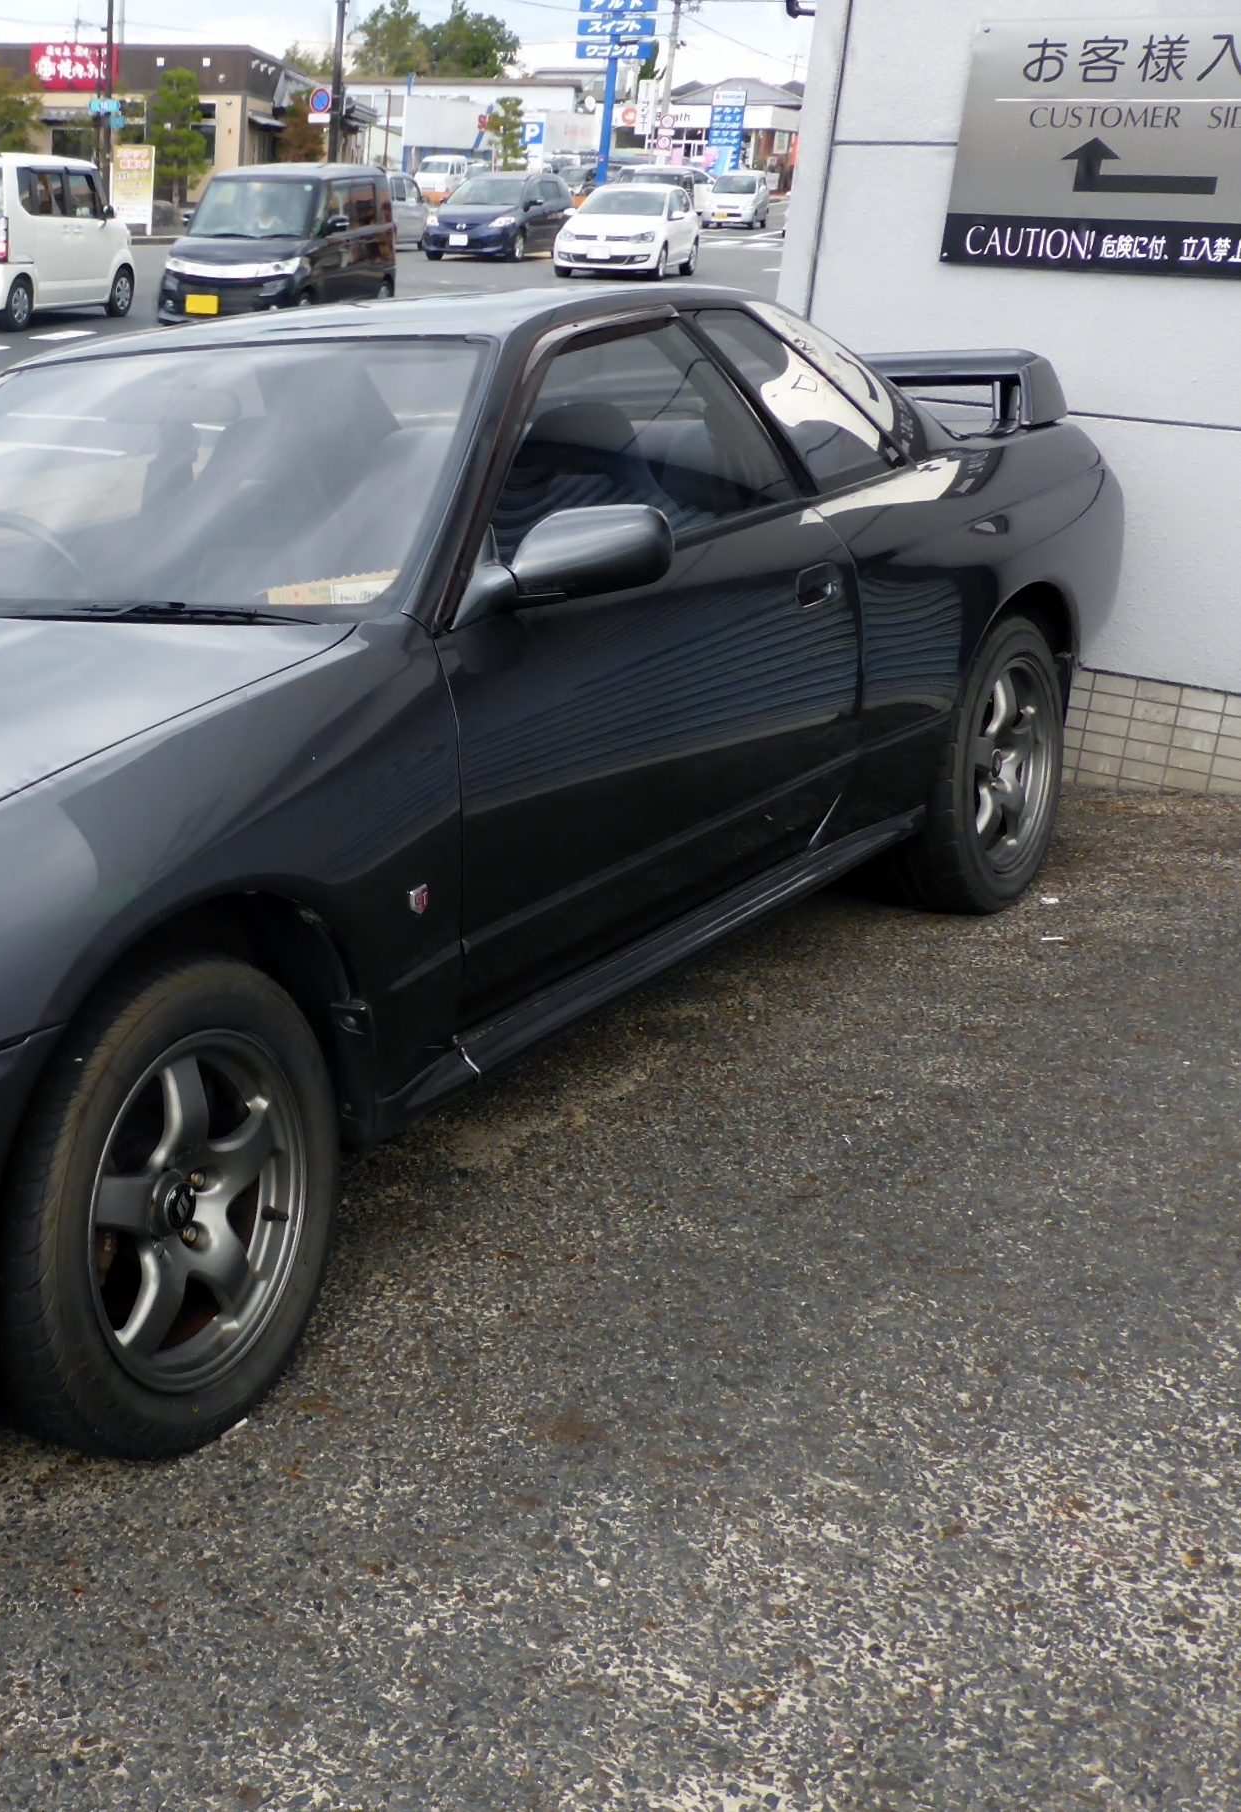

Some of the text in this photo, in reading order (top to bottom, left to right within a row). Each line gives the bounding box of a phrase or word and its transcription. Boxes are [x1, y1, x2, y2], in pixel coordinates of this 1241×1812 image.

[587, 20, 642, 32] スイフト
[585, 44, 639, 56] ワゴンR
[1023, 33, 1241, 82] お客様入
[1029, 106, 1181, 129] CUSTOMER
[524, 123, 540, 142] P
[965, 225, 1097, 261] CAUTION!
[1178, 236, 1241, 262] 立入禁止
[415, 891, 428, 906] GT
